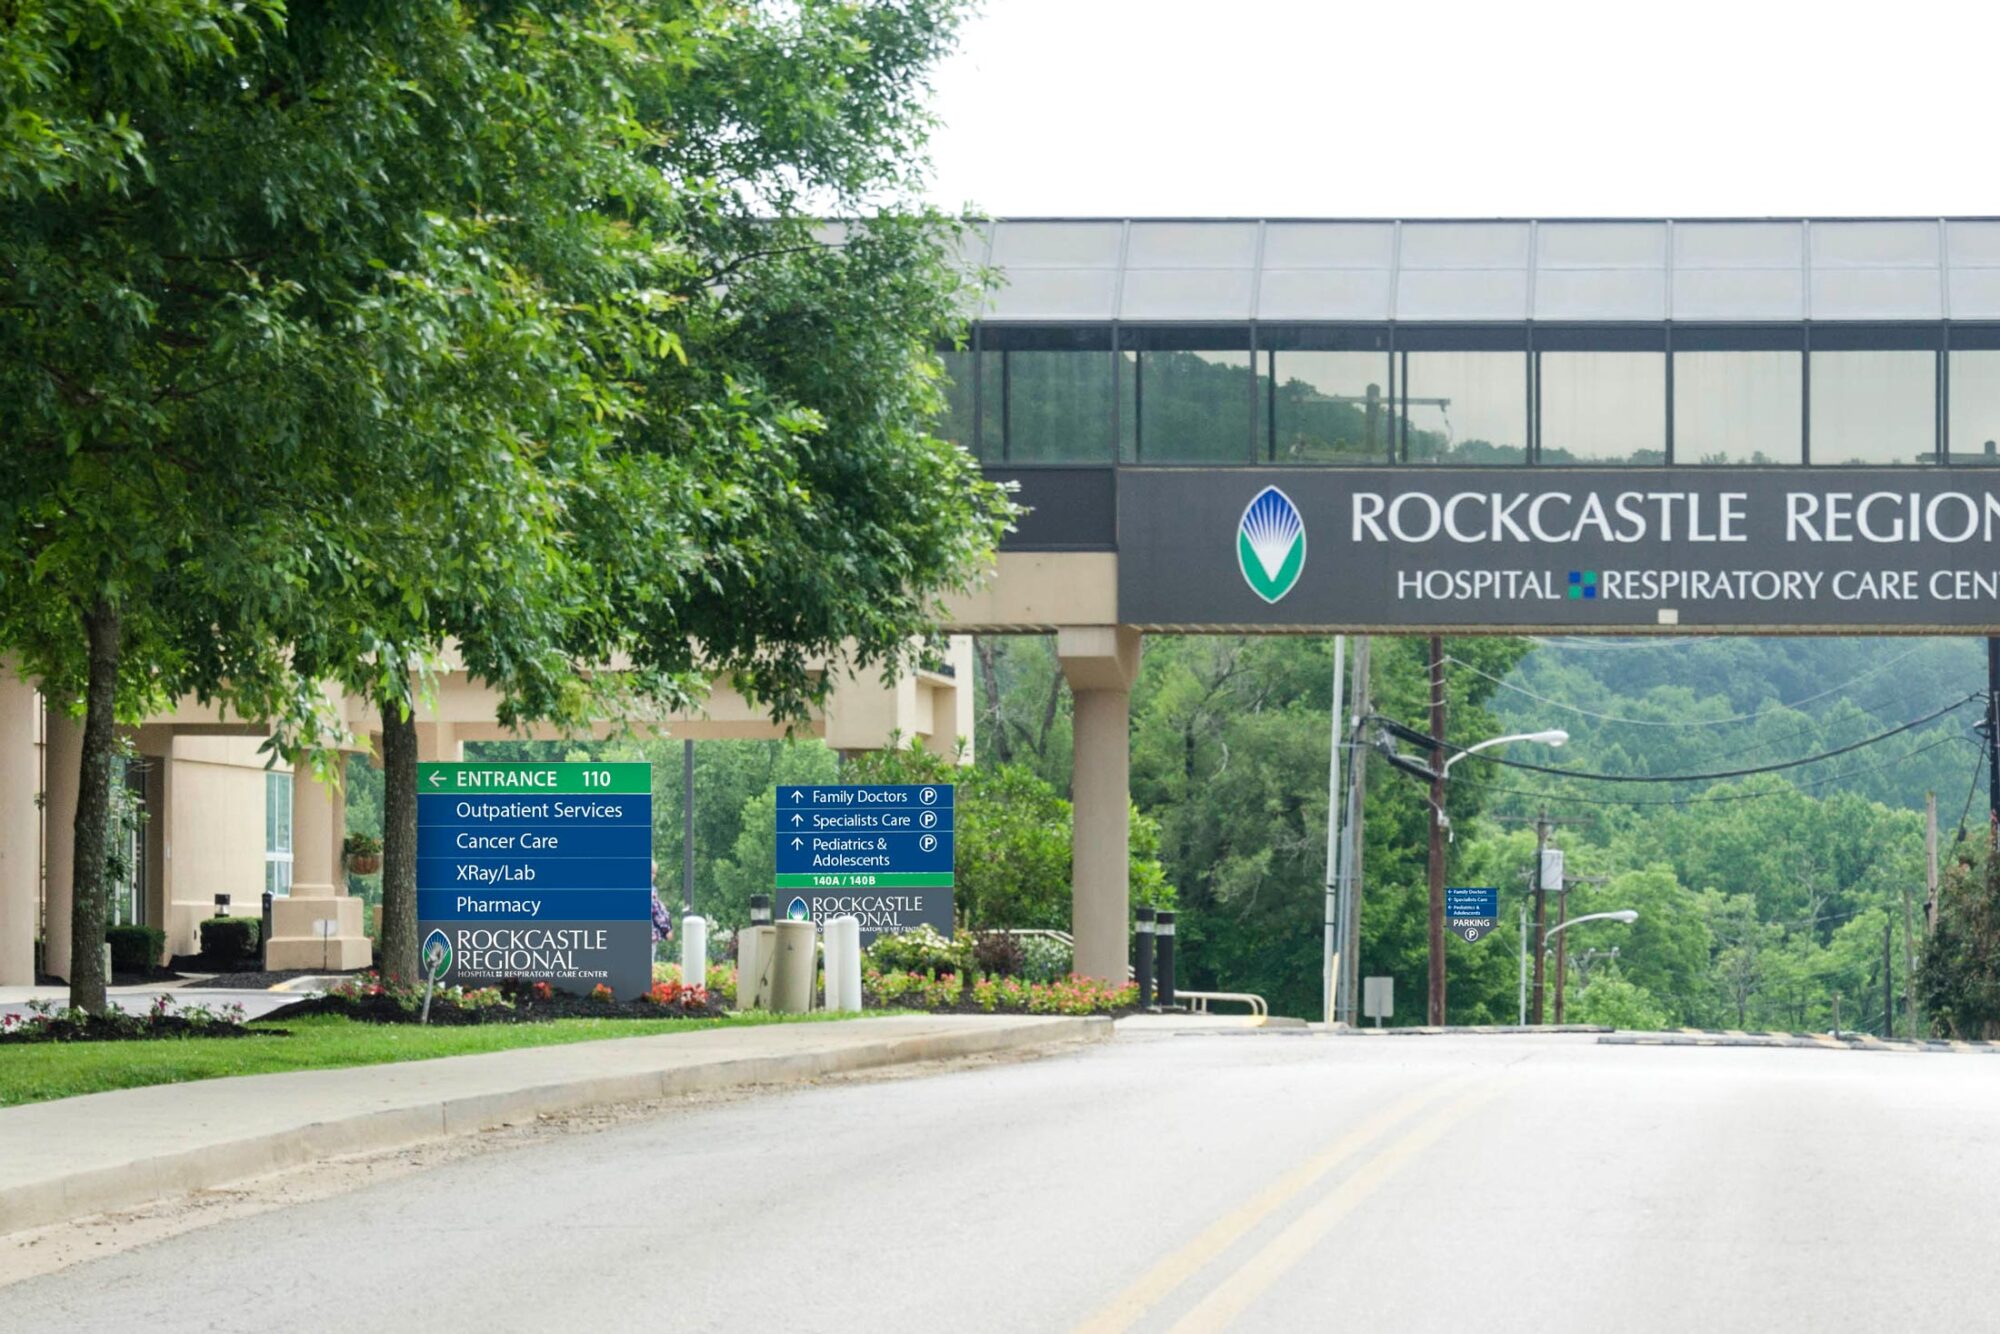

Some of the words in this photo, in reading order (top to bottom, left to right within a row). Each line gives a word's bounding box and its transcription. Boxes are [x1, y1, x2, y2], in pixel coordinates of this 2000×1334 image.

[1352, 491, 1748, 543] ROCKCASTLE
[1397, 570, 1561, 600] HOSPITAL
[1602, 570, 1824, 600] RESPIRATORY
[1832, 570, 1919, 600] CARE
[1930, 571, 2000, 600] CEN
[457, 770, 558, 787] ENTRANCE
[582, 770, 611, 787] 110
[813, 790, 855, 806] Family
[857, 789, 908, 803] Doctors
[456, 801, 549, 822] Outpatient
[554, 801, 623, 818] Services
[813, 813, 879, 830] Specialists
[881, 813, 911, 827] Care
[456, 832, 516, 849] Cancer
[519, 832, 559, 849] Care
[813, 837, 875, 851] Pediatrics
[876, 837, 887, 850] &
[812, 853, 890, 867] Adolescents
[456, 864, 536, 885] XRay/Lab
[813, 876, 840, 886] 140A
[849, 875, 876, 886] 140B
[457, 895, 541, 917] Pharmacy
[812, 896, 923, 912] ROCKCASTLE
[813, 912, 902, 926] RONAL
[457, 929, 607, 950] ROCKCASTLE
[457, 949, 579, 970] REGIONAL
[457, 970, 495, 978] HOSPITAL
[504, 970, 555, 978] RESPIRATORY
[556, 970, 577, 978] CARE
[578, 970, 608, 978] CENTER
